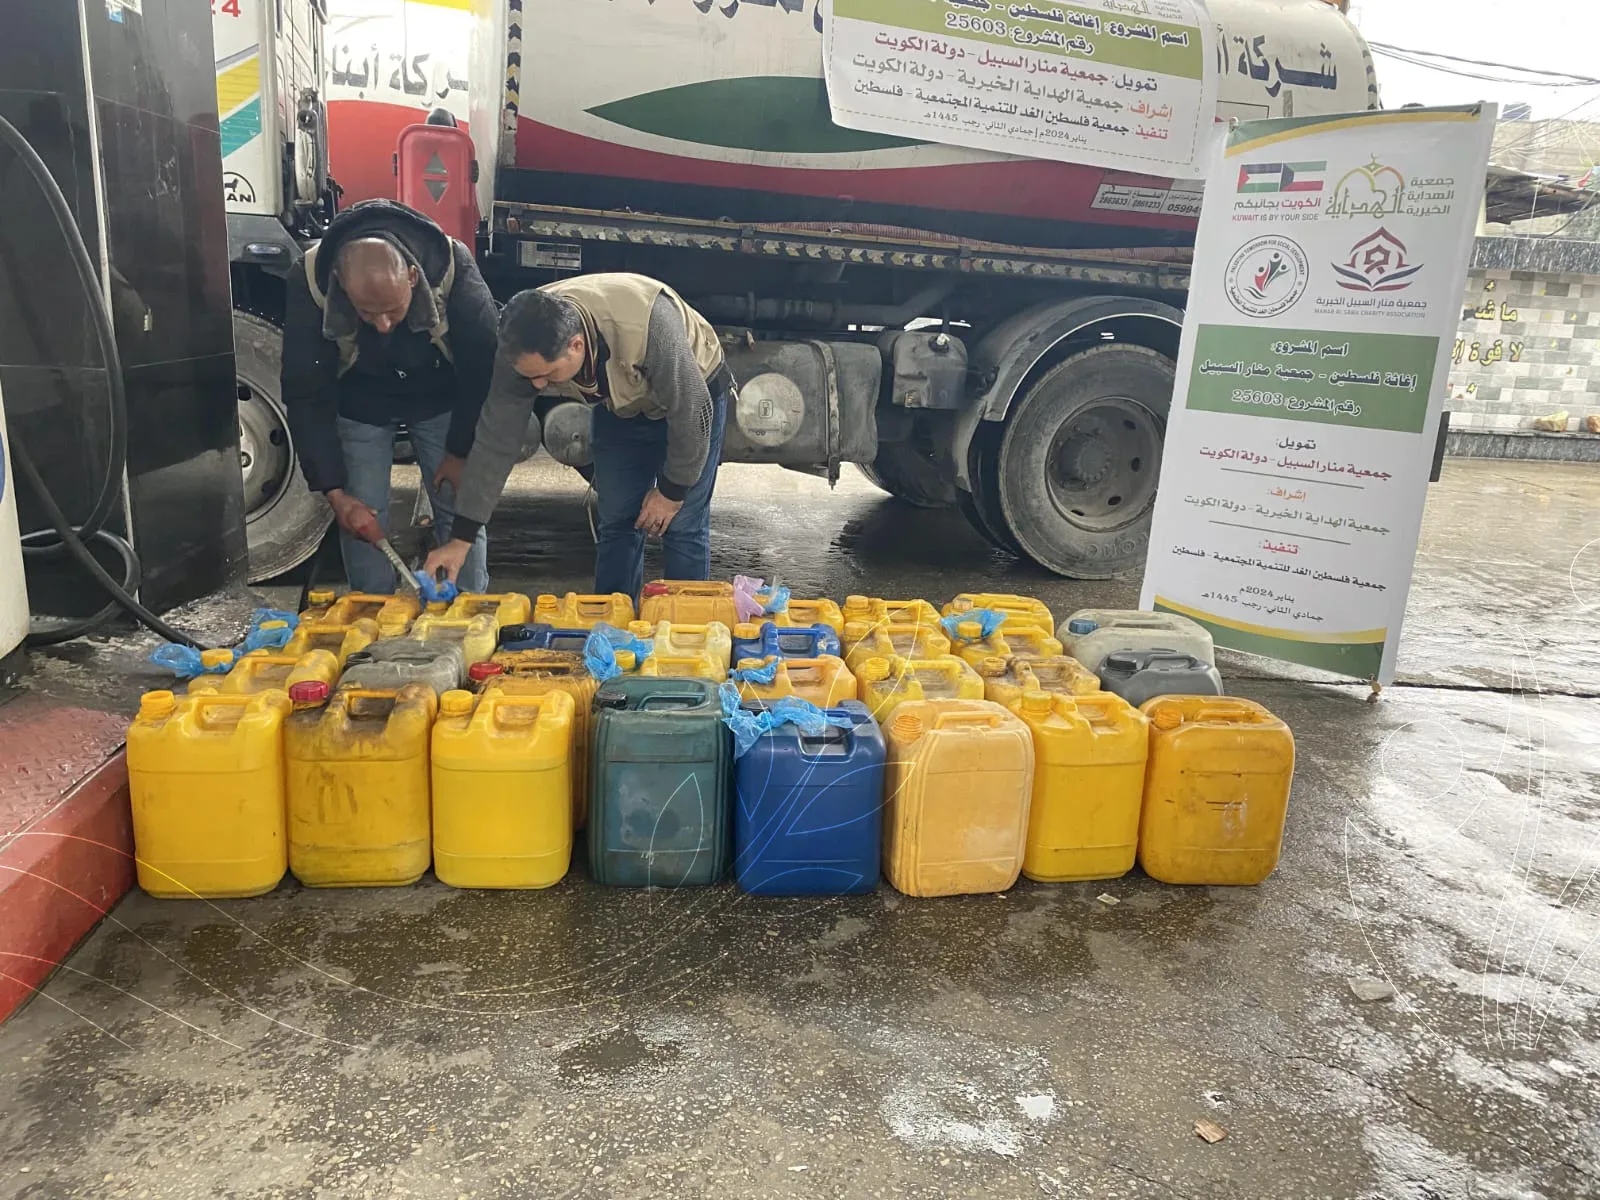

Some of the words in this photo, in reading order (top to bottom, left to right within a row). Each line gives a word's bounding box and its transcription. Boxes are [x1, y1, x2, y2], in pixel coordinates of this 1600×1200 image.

[1009, 3, 1064, 23] فلسطين
[945, 12, 1006, 36] 25603
[1067, 11, 1100, 33] إغاثة
[1010, 27, 1065, 45] المشروع:
[1106, 21, 1157, 40] المشروع:
[874, 31, 929, 52] الكويت
[1066, 35, 1094, 54] رقم
[1162, 32, 1189, 47] اسم
[931, 39, 966, 59] دولة
[852, 54, 907, 75] الكويت
[977, 49, 1028, 70] السبيل
[1029, 58, 1058, 76] منار
[908, 61, 944, 82] دولة
[1061, 62, 1108, 86] جمعية
[854, 78, 903, 97] فلسطين
[957, 68, 1019, 93] الخيرية
[1112, 73, 1158, 92] تمويل:
[914, 87, 972, 109] المجتمعية
[1024, 80, 1075, 104] الهداية
[974, 97, 1017, 115] للتنمية
[1077, 90, 1124, 113] جمعية
[1020, 106, 1044, 119] الغد
[1045, 109, 1090, 128] فلسطين
[1127, 100, 1173, 122] إشراف:
[961, 118, 980, 128] رجب
[1091, 117, 1129, 136] جمعية
[1039, 127, 1069, 139] 2024م
[1132, 124, 1168, 140] تنفيذ:
[1070, 135, 1088, 145] يناير
[1410, 177, 1455, 188] جمعية
[225, 193, 251, 203] AN
[1281, 197, 1321, 210] الكويت
[1407, 190, 1455, 202] الهداية
[1233, 199, 1280, 211] بجانبكم
[1406, 205, 1450, 217] الخيرية
[1232, 213, 1259, 222] KUWAIT
[1269, 213, 1278, 221] BY
[1280, 213, 1300, 221] YOUR
[1302, 213, 1319, 221] SIDE
[1315, 296, 1345, 307] الخيرية
[1346, 298, 1376, 308] السبيل
[1376, 298, 1395, 308] منار
[1396, 300, 1427, 310] جمعية
[1500, 301, 1517, 321] ما
[1271, 340, 1319, 355] المشروع:
[1321, 343, 1349, 359] اسم
[1469, 339, 1503, 366] قوة
[1200, 360, 1243, 375] السبيل
[1244, 362, 1271, 377] منار
[1275, 364, 1314, 382] جمعية
[1329, 369, 1381, 386] فلسطين
[1384, 372, 1417, 392] إغاثة
[1231, 389, 1283, 406] 25603
[1284, 397, 1335, 411] المشروع:
[1334, 400, 1361, 416] رقم
[1276, 437, 1316, 450] تمويل:
[1199, 446, 1240, 460] الكويت
[1241, 450, 1268, 464] دولة
[1277, 456, 1320, 470] السبيل
[1319, 461, 1345, 473] منار
[1347, 463, 1392, 481] جمعية
[1184, 495, 1221, 507] الكويت
[1222, 498, 1246, 512] دولة
[1256, 504, 1302, 519] الخيرية
[1305, 512, 1346, 528] الهداية
[1347, 518, 1390, 535] جمعية
[1172, 545, 1206, 557] فلسطين
[1259, 540, 1299, 554] تنفيذ:
[1213, 551, 1255, 566] المجتمعية
[1256, 560, 1290, 573] للتنمية
[1292, 567, 1312, 577] الغد
[1312, 570, 1350, 584] فلسطين
[1352, 576, 1387, 592] جمعية
[1240, 585, 1274, 598] 2024م
[1273, 593, 1295, 604] يناير
[1242, 600, 1262, 611] رجب
[1293, 612, 1324, 622] جمادي
